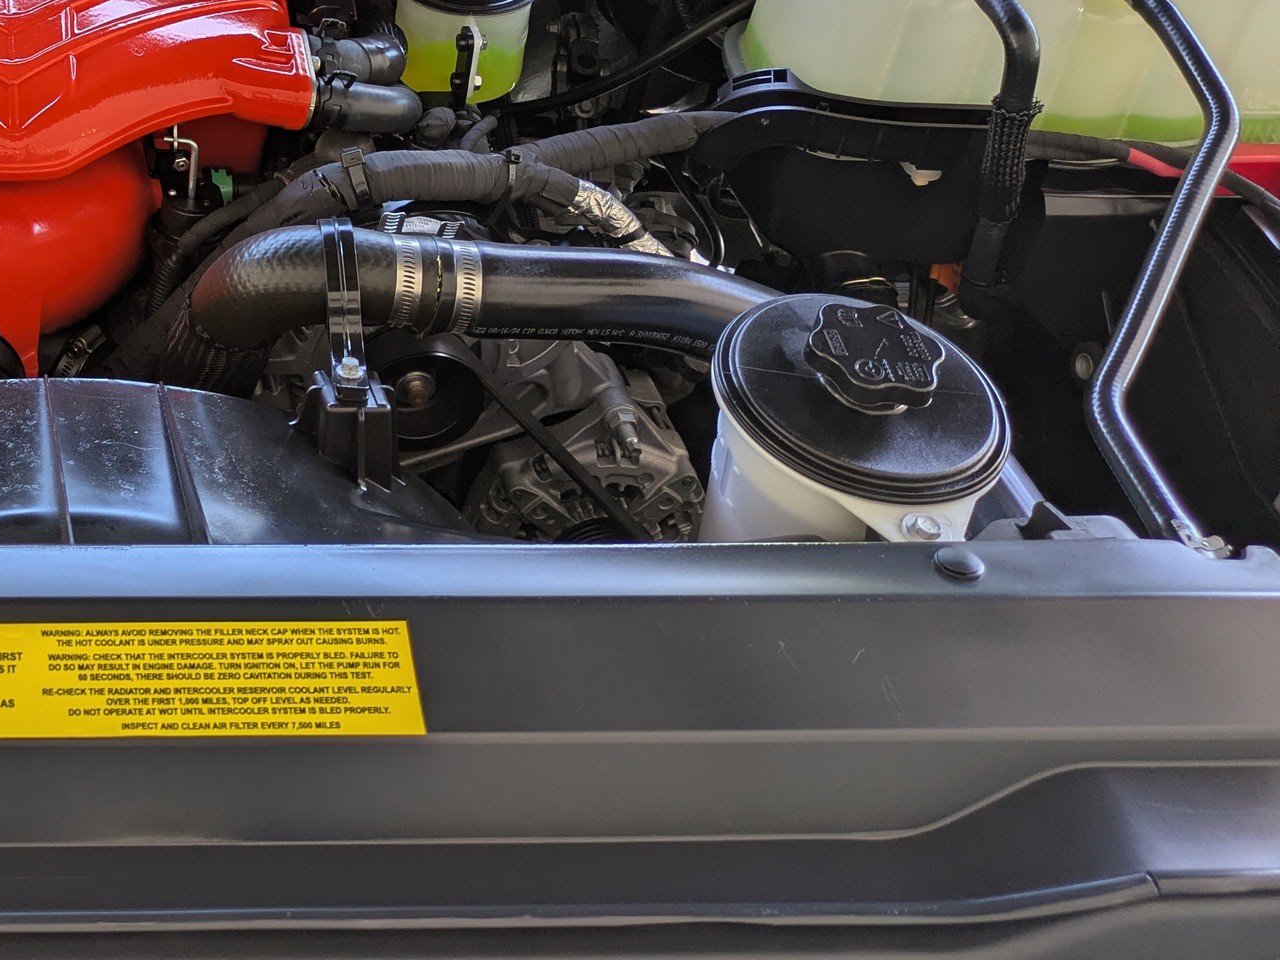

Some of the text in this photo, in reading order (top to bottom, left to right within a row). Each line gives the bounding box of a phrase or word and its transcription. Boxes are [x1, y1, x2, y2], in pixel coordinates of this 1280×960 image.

[6, 665, 16, 674] IT
[282, 662, 299, 671] ON,
[89, 674, 134, 682] SECONDS,
[0, 699, 16, 709] AS
[178, 698, 200, 706] 1,000
[200, 698, 230, 706] MILES,
[291, 722, 314, 730] 7,500
